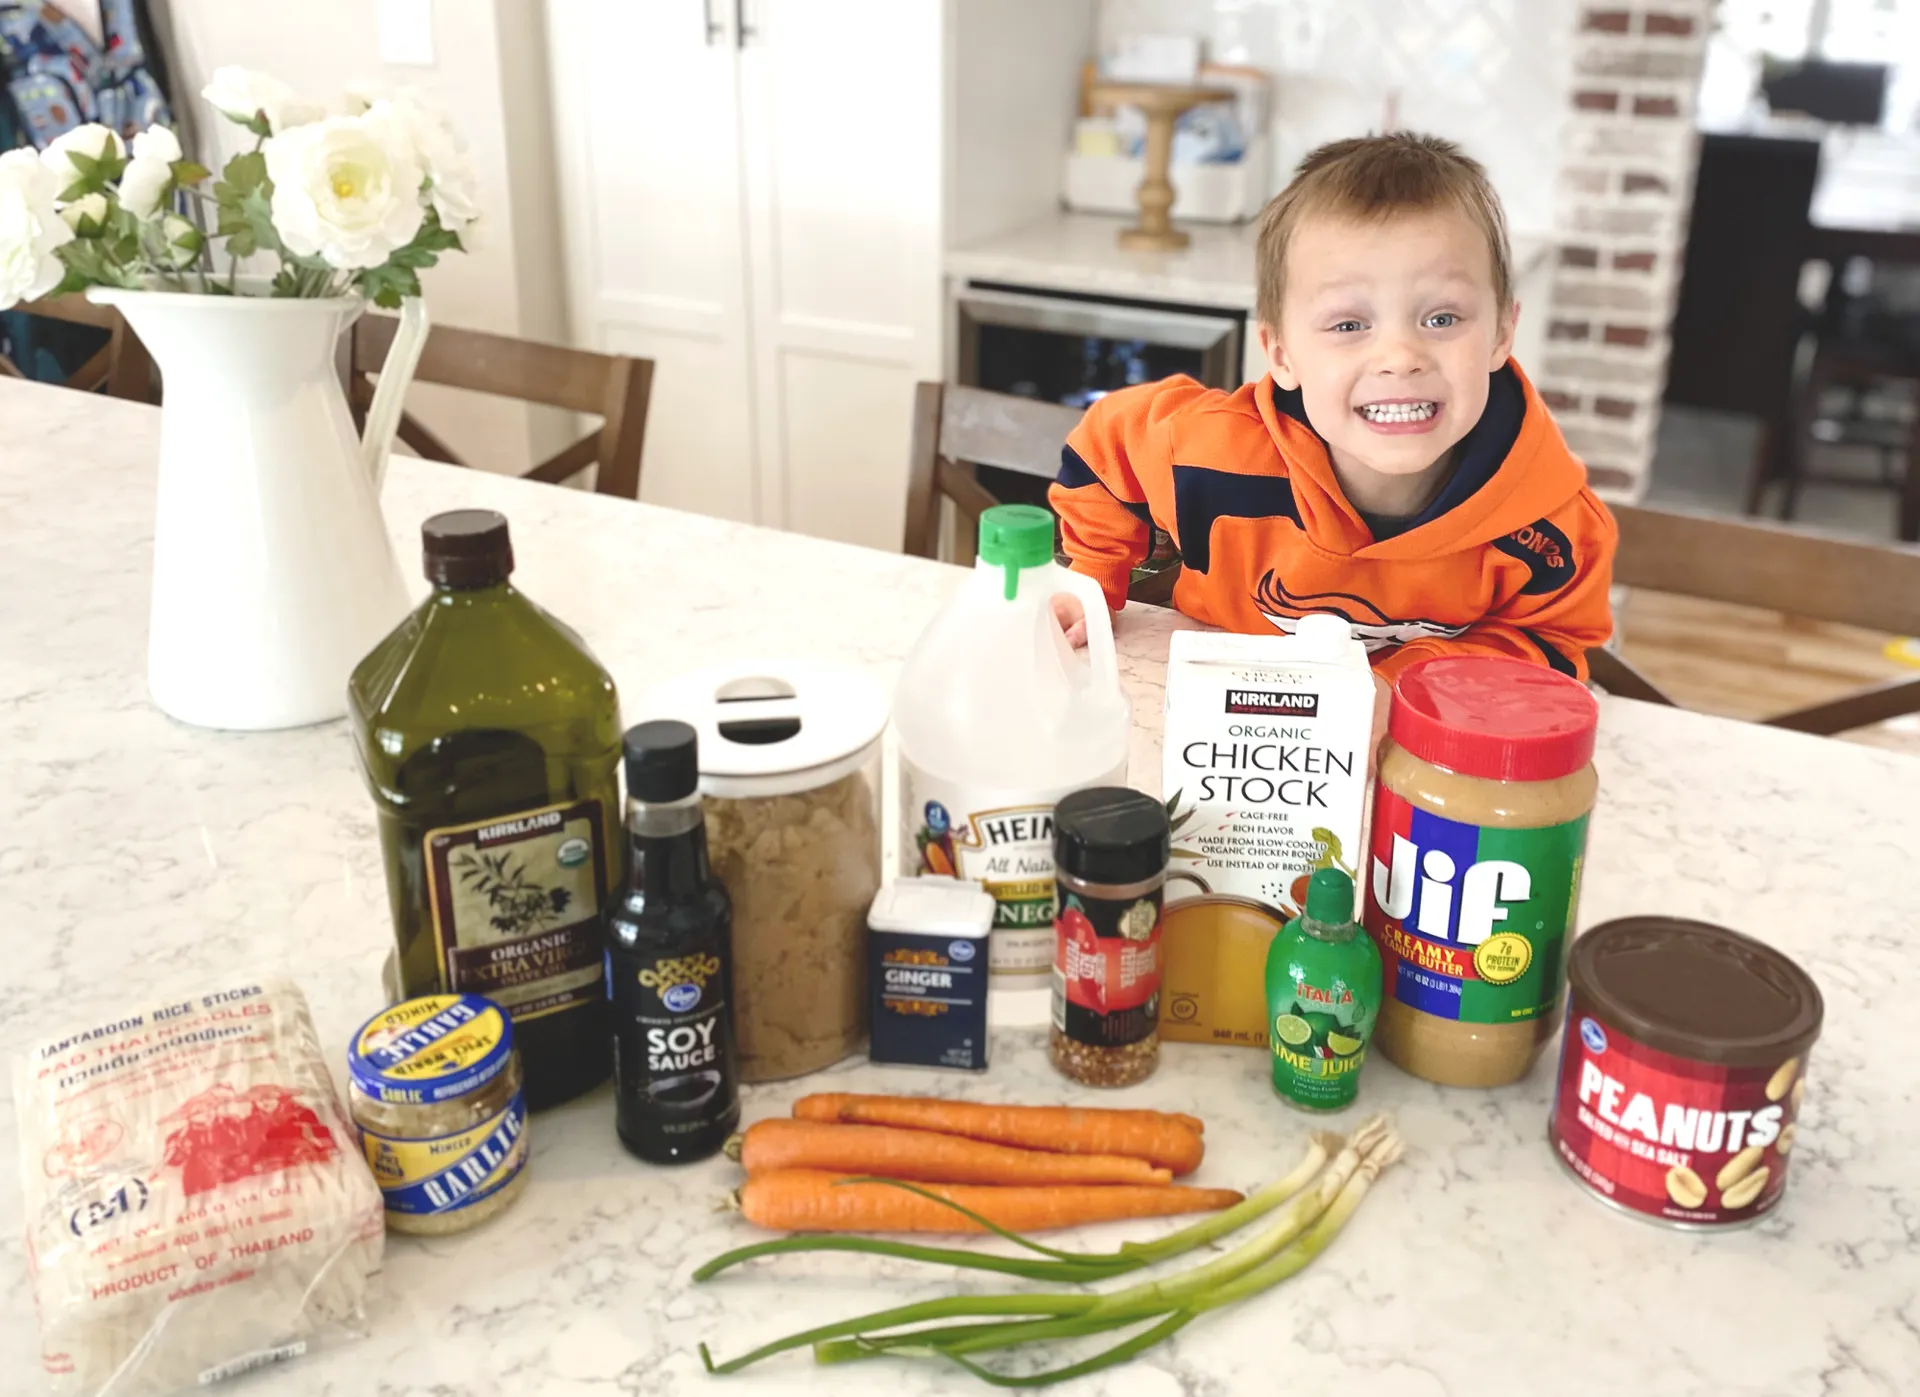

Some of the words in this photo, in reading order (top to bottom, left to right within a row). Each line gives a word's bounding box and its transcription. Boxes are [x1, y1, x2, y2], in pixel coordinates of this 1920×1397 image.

[1231, 692, 1315, 708] KIRKLAND
[1228, 725, 1312, 741] ORGANIC
[1183, 742, 1353, 777] CHICKEN
[1199, 775, 1328, 808] STOCK
[478, 811, 562, 842] KIRKLAND
[986, 815, 1056, 846] HEIN
[1232, 824, 1255, 833] RICH
[1257, 825, 1294, 835] FLAVOR
[1240, 811, 1289, 821] CAGE-FREE
[1198, 835, 1225, 845] MADE
[1227, 836, 1255, 846] FROM
[1256, 838, 1327, 851] SLOW-COOKED
[1201, 845, 1245, 856] ORGANIC
[1247, 847, 1289, 857] CHICKEN
[1291, 849, 1323, 861] BONES
[986, 857, 1011, 873] All
[1207, 859, 1224, 869] USE
[1226, 860, 1264, 870] INSTEAD
[1266, 862, 1280, 870] OF
[1373, 832, 1531, 945] Jif
[491, 930, 572, 961] ORGANIC
[1380, 932, 1416, 961] PEANUT
[1418, 956, 1464, 977] BUTTER
[1385, 923, 1456, 963] CREAMY
[1486, 954, 1520, 967] PROTEIN
[885, 969, 952, 989] GINGER
[1297, 981, 1353, 1004] ITALIA
[152, 1001, 194, 1022] RICE
[202, 985, 262, 1008] STICKS
[96, 1034, 151, 1058] THAI
[647, 1017, 716, 1055] SOY
[648, 1044, 716, 1072] SAUCE
[1578, 1058, 1784, 1154] PEANUTS
[423, 1110, 521, 1208] GARLIC
[1631, 1139, 1656, 1161] SEA
[1656, 1149, 1690, 1168] SALT
[91, 1263, 179, 1300] PRODUCT
[195, 1252, 219, 1271] OF
[228, 1228, 314, 1261] THAILAND
